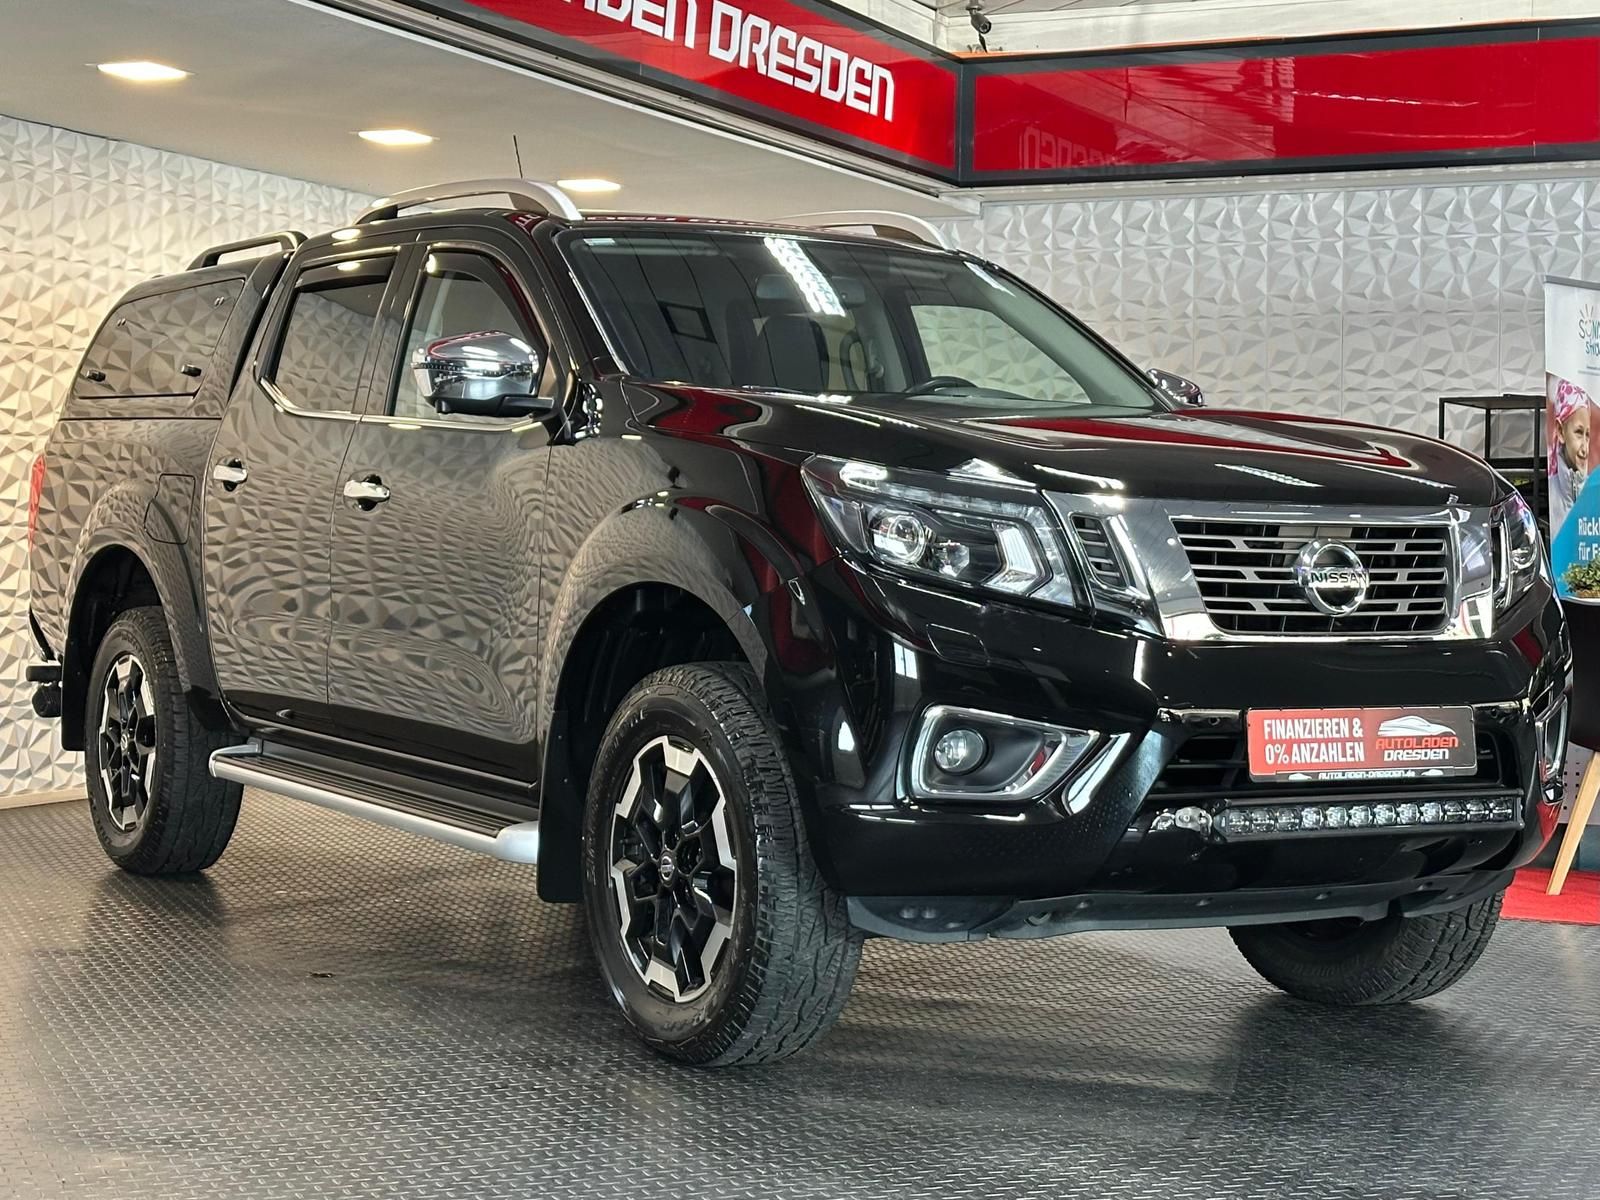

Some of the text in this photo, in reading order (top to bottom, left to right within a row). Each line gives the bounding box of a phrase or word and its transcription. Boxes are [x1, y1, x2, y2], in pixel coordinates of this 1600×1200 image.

[709, 0, 895, 122] DRESDEN
[1578, 542, 1590, 561] für
[1311, 571, 1367, 584] NISSAN
[1264, 717, 1363, 739] FINANZIEREN &
[1375, 736, 1459, 750] AUTOLADEN
[1265, 741, 1365, 765] 0% ANZAHLEN
[1384, 748, 1449, 762] DRESDEN
